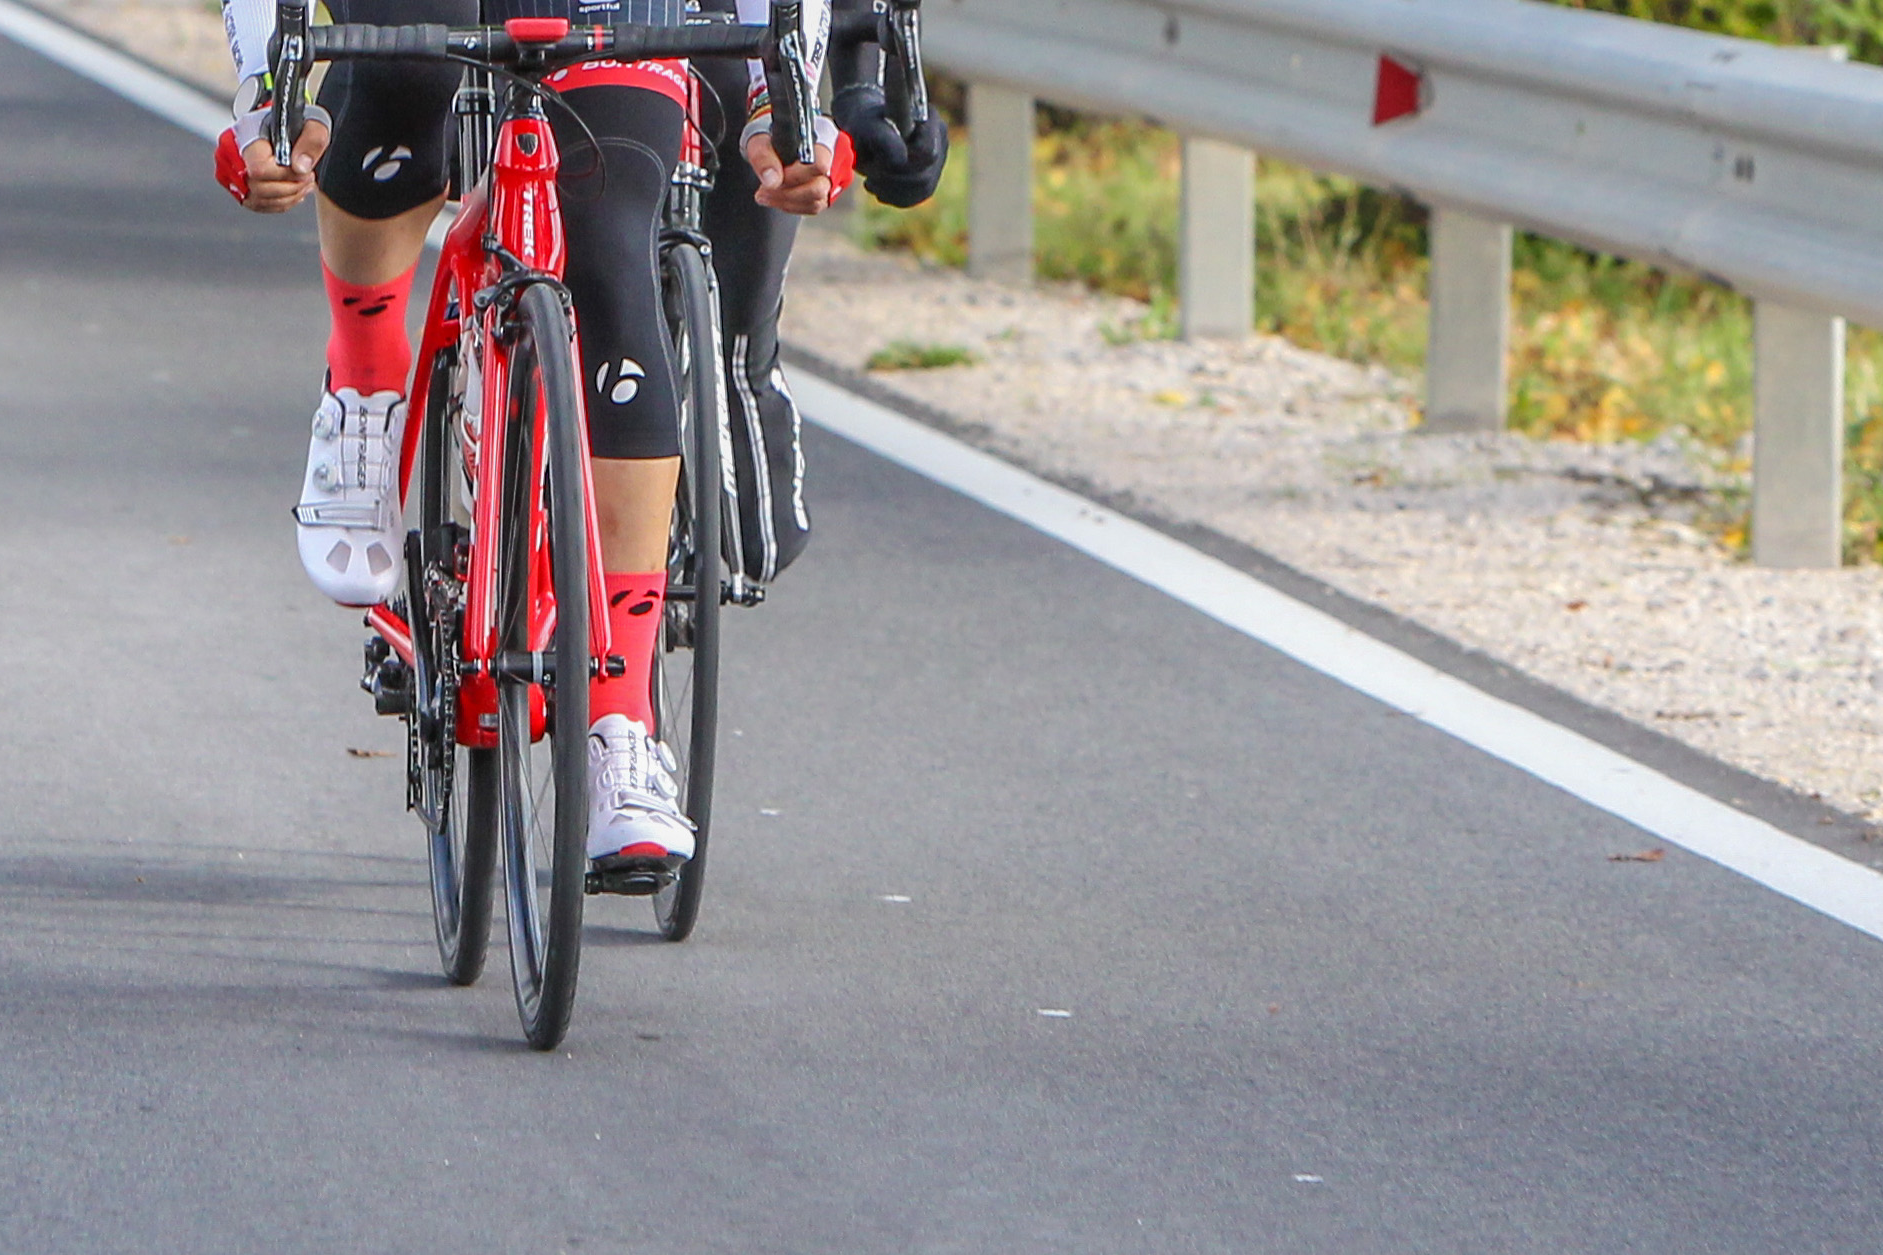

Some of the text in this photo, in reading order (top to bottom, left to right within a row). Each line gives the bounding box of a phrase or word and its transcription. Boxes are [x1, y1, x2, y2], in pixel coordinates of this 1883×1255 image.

[578, 3, 621, 14] sportful
[523, 187, 535, 258] TREK
[358, 406, 368, 490] BONTRAGER
